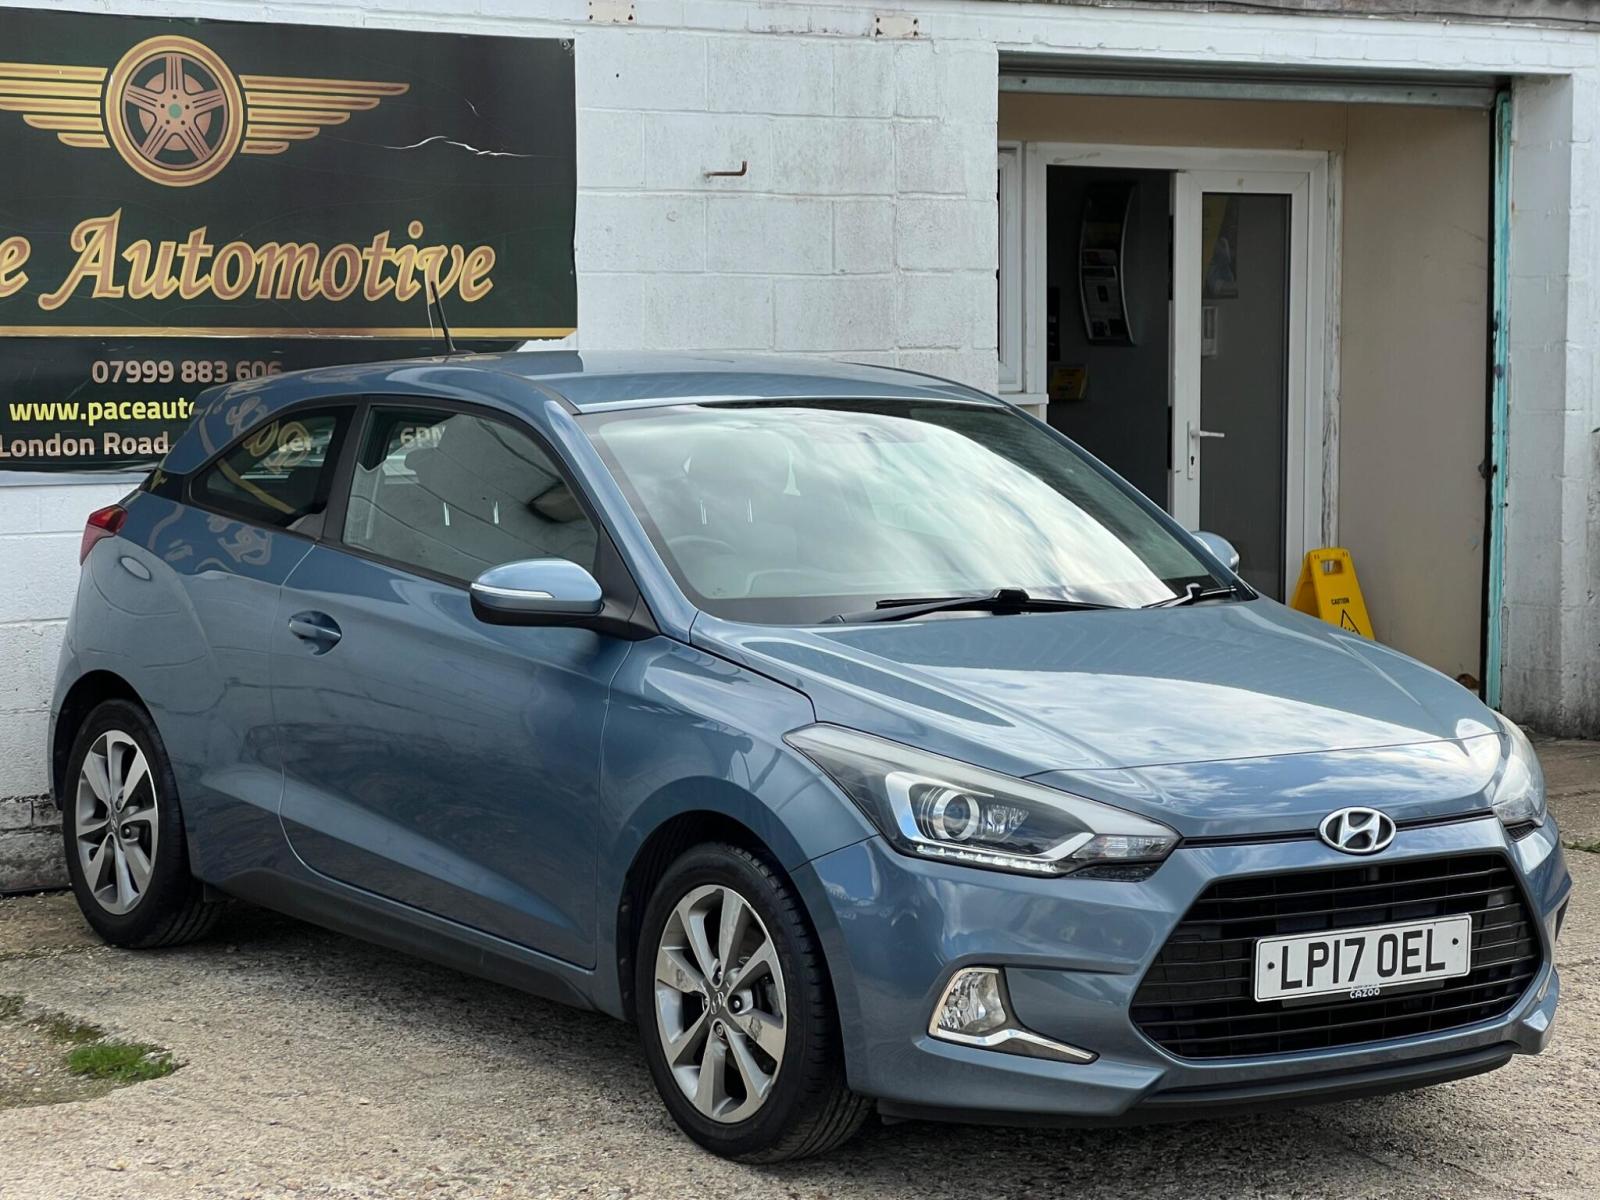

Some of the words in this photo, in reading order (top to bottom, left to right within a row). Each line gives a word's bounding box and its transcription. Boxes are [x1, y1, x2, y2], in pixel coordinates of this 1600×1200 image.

[38, 207, 496, 310] Automotive
[91, 360, 175, 384] 07999
[180, 360, 229, 383] 883
[235, 360, 283, 382] 606
[0, 432, 95, 458] London
[103, 431, 169, 455] Road
[1281, 937, 1366, 990] LP17
[1350, 988, 1380, 999] CAZOO
